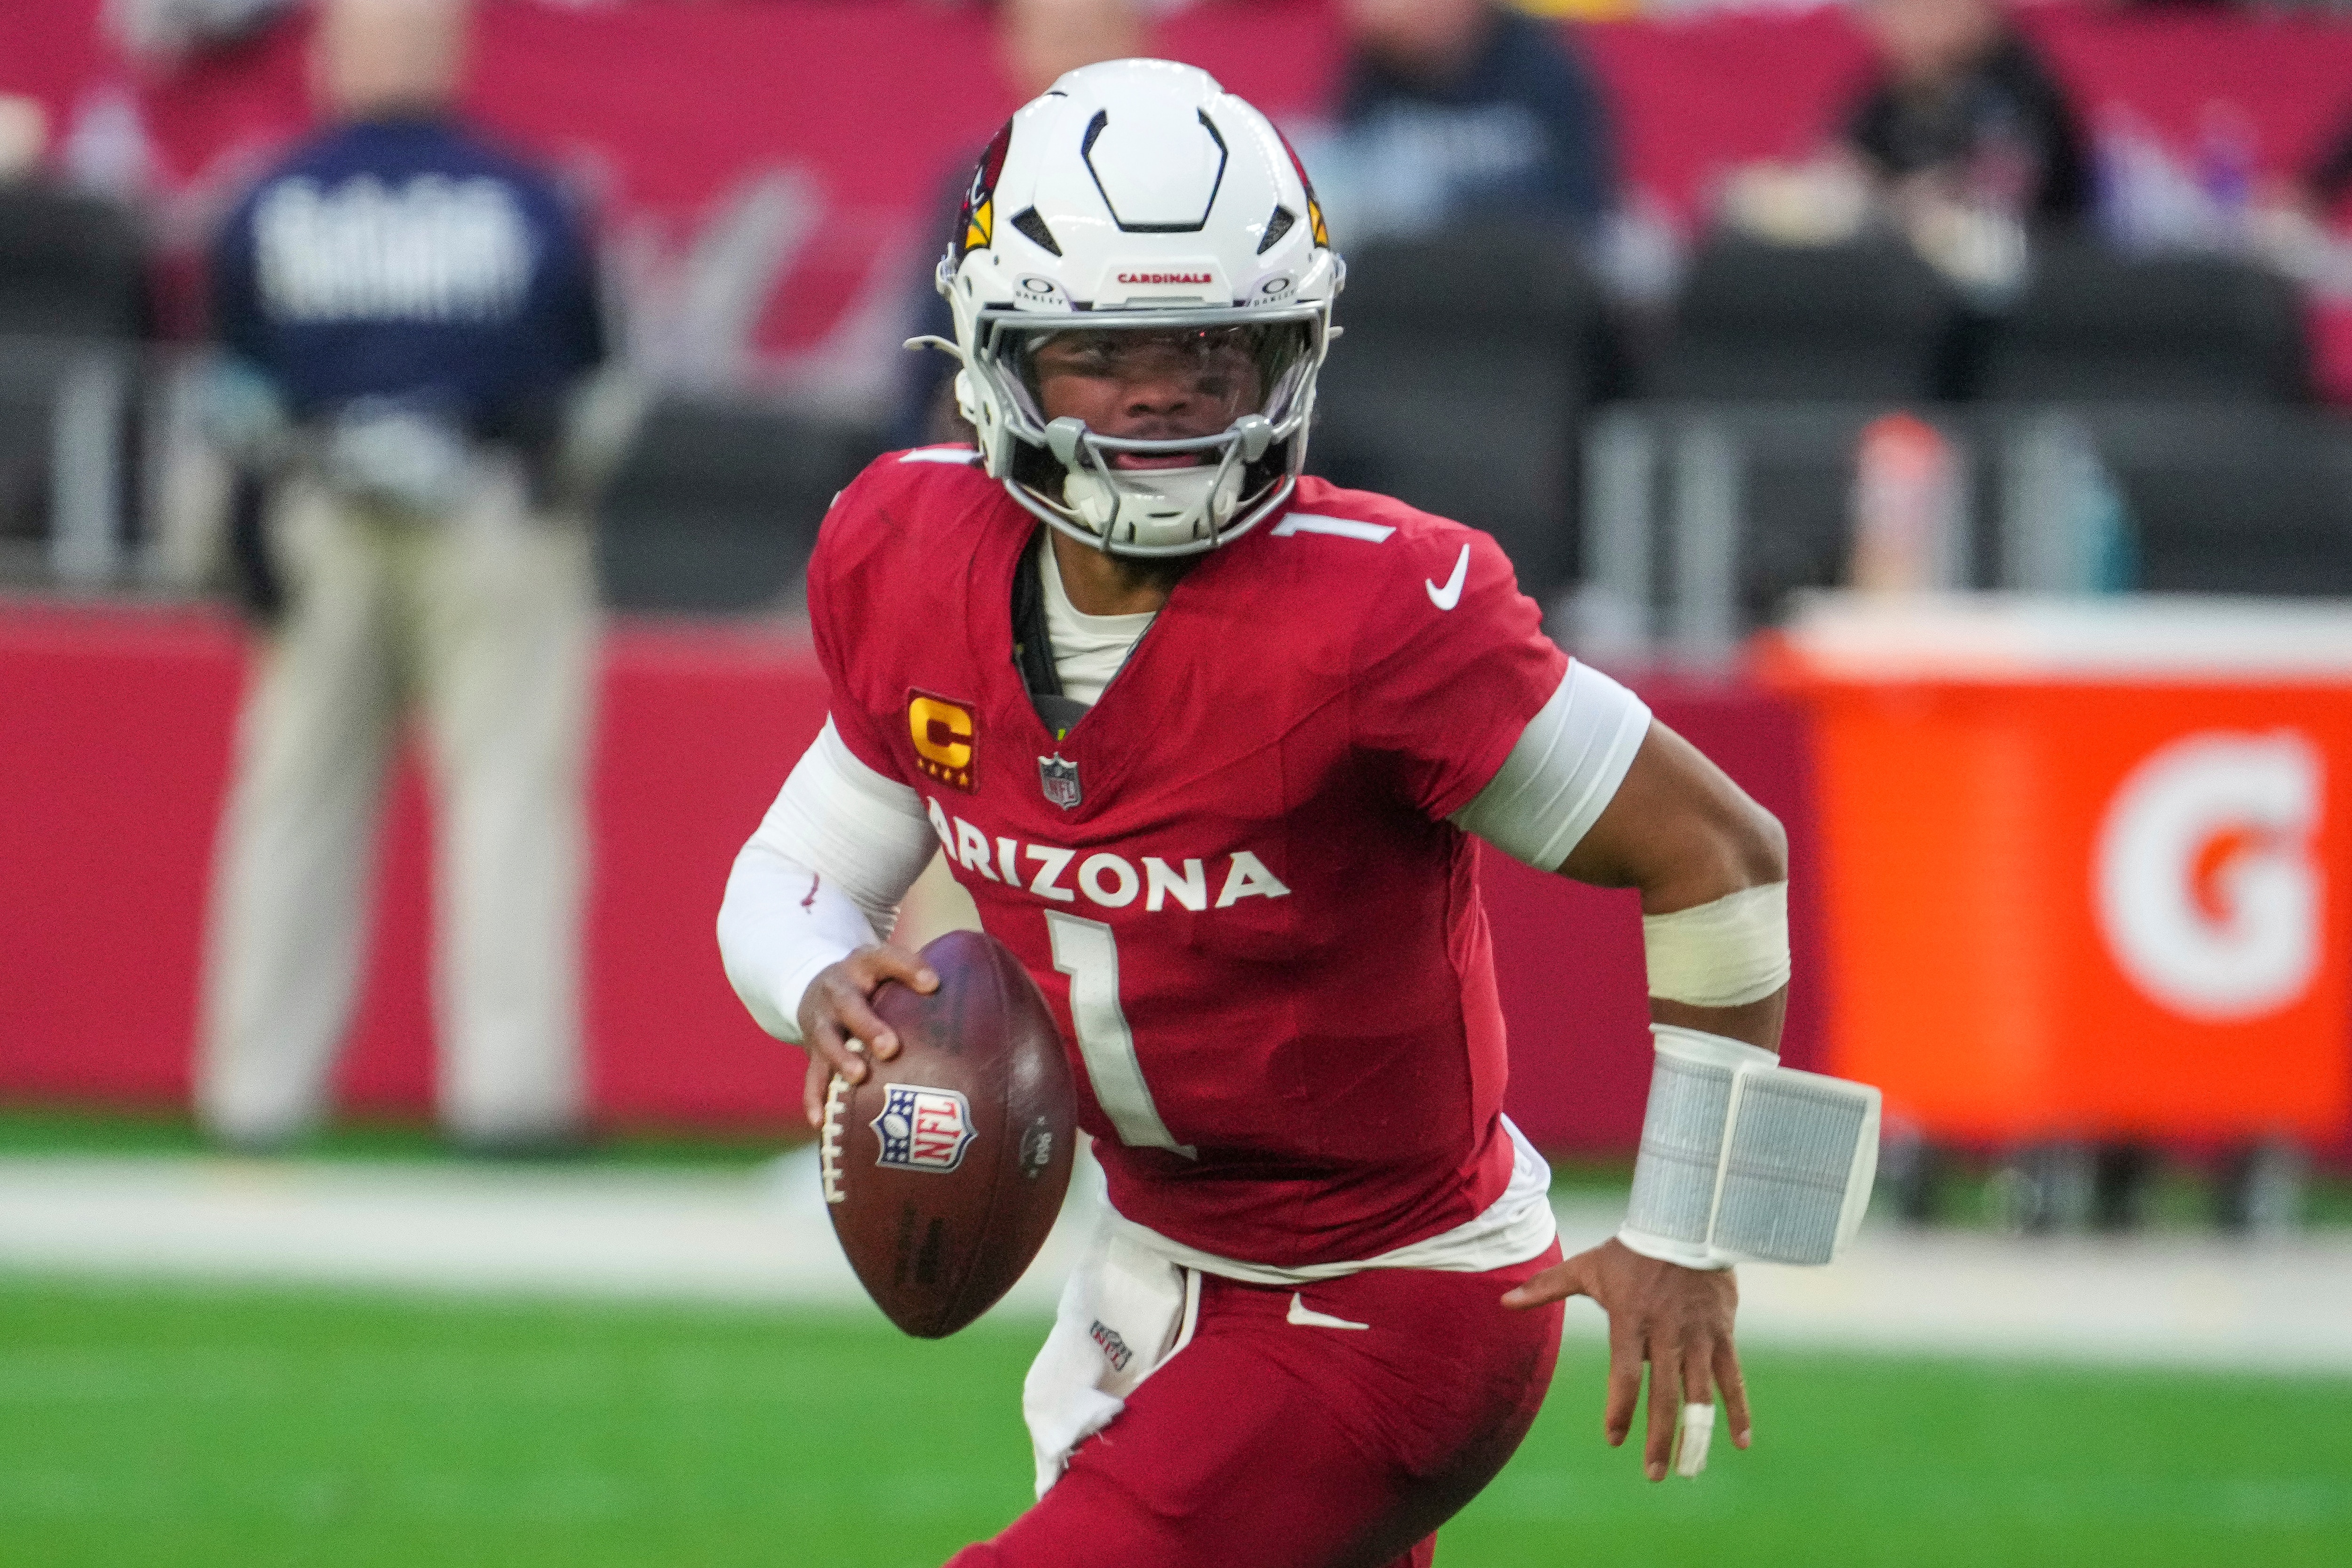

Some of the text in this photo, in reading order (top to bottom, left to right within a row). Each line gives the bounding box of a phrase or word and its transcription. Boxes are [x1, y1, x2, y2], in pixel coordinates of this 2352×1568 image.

[1117, 273, 1212, 283] CARDINALS
[1269, 512, 1398, 544] 1
[909, 697, 972, 768] C
[2091, 731, 2325, 1021] G
[1044, 908, 1198, 1161] 1
[914, 1101, 961, 1162] NFL
[1093, 1330, 1119, 1369] NFL
